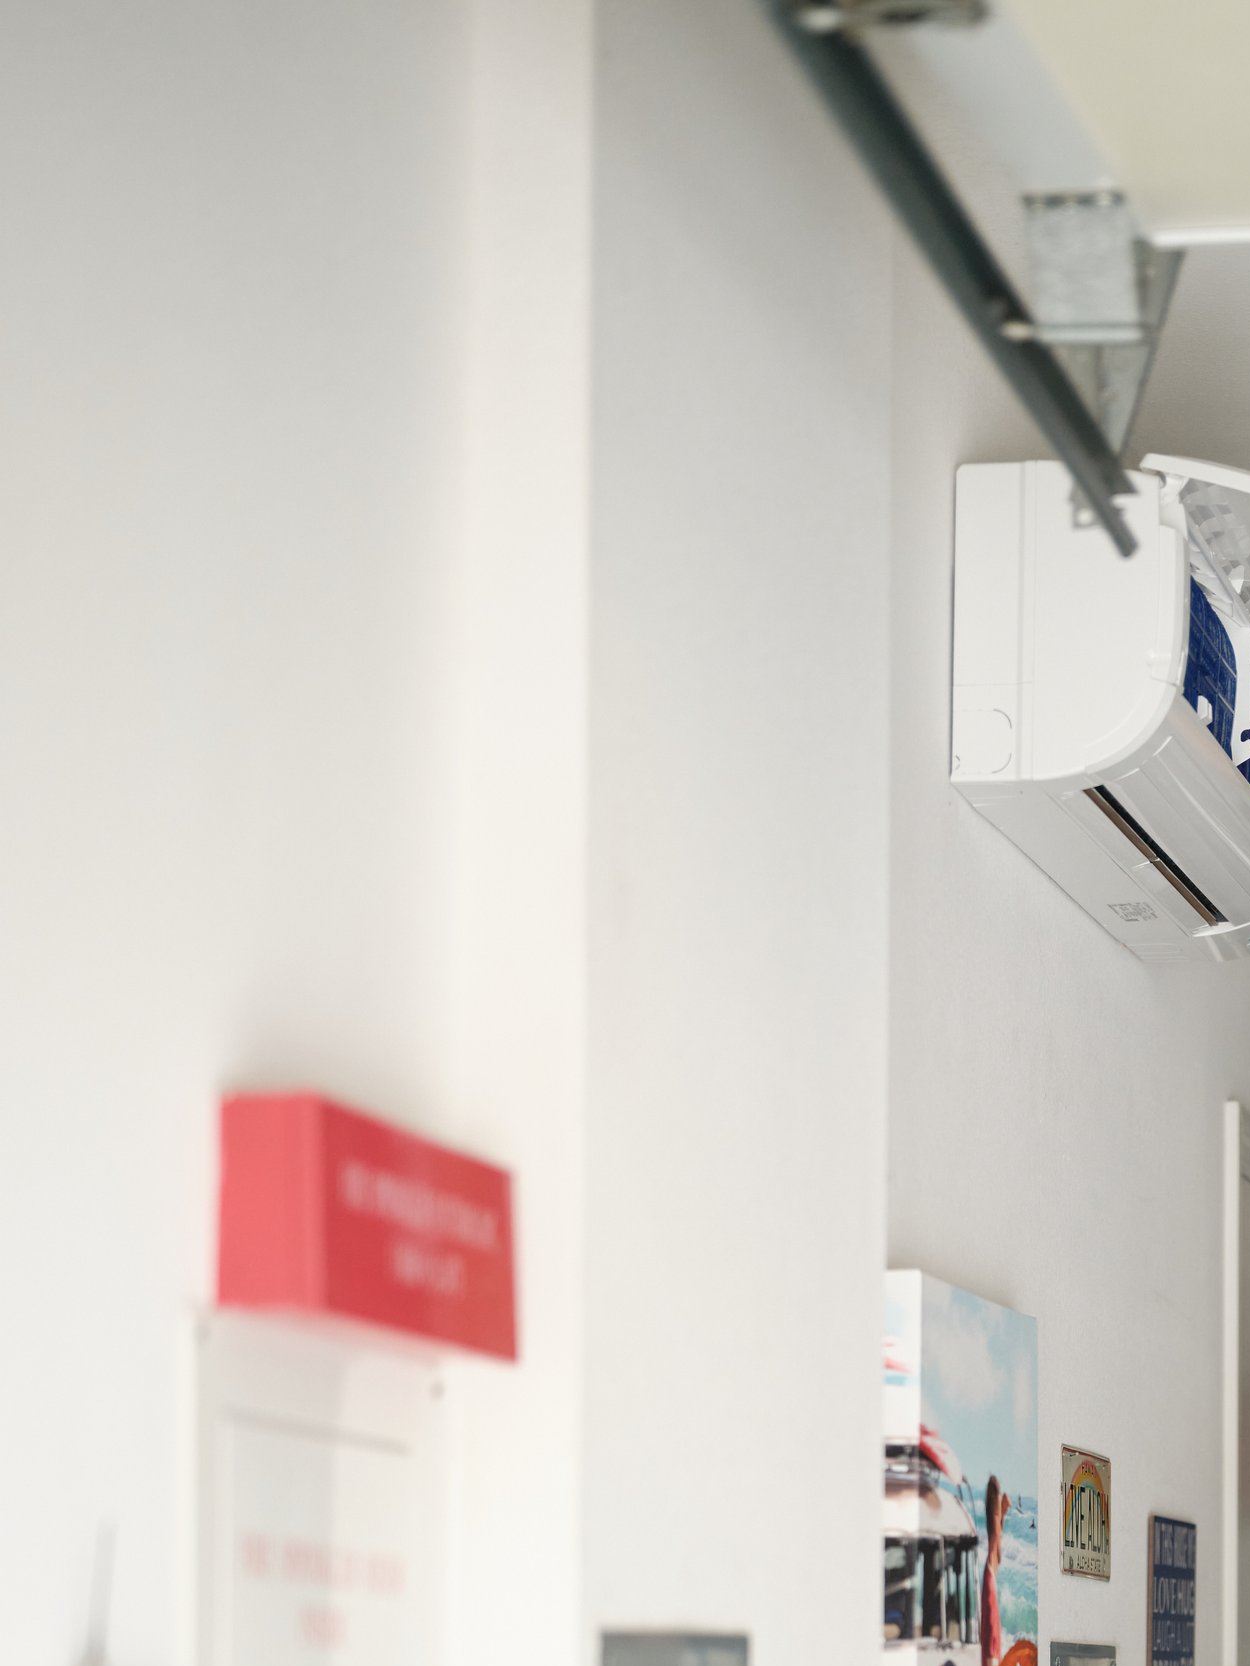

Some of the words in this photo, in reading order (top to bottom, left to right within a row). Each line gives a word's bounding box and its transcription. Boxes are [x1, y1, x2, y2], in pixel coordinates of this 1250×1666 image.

[1064, 1482, 1086, 1550] LIVE
[1087, 1488, 1110, 1555] ALOHA
[1153, 1576, 1177, 1614] LOVE
